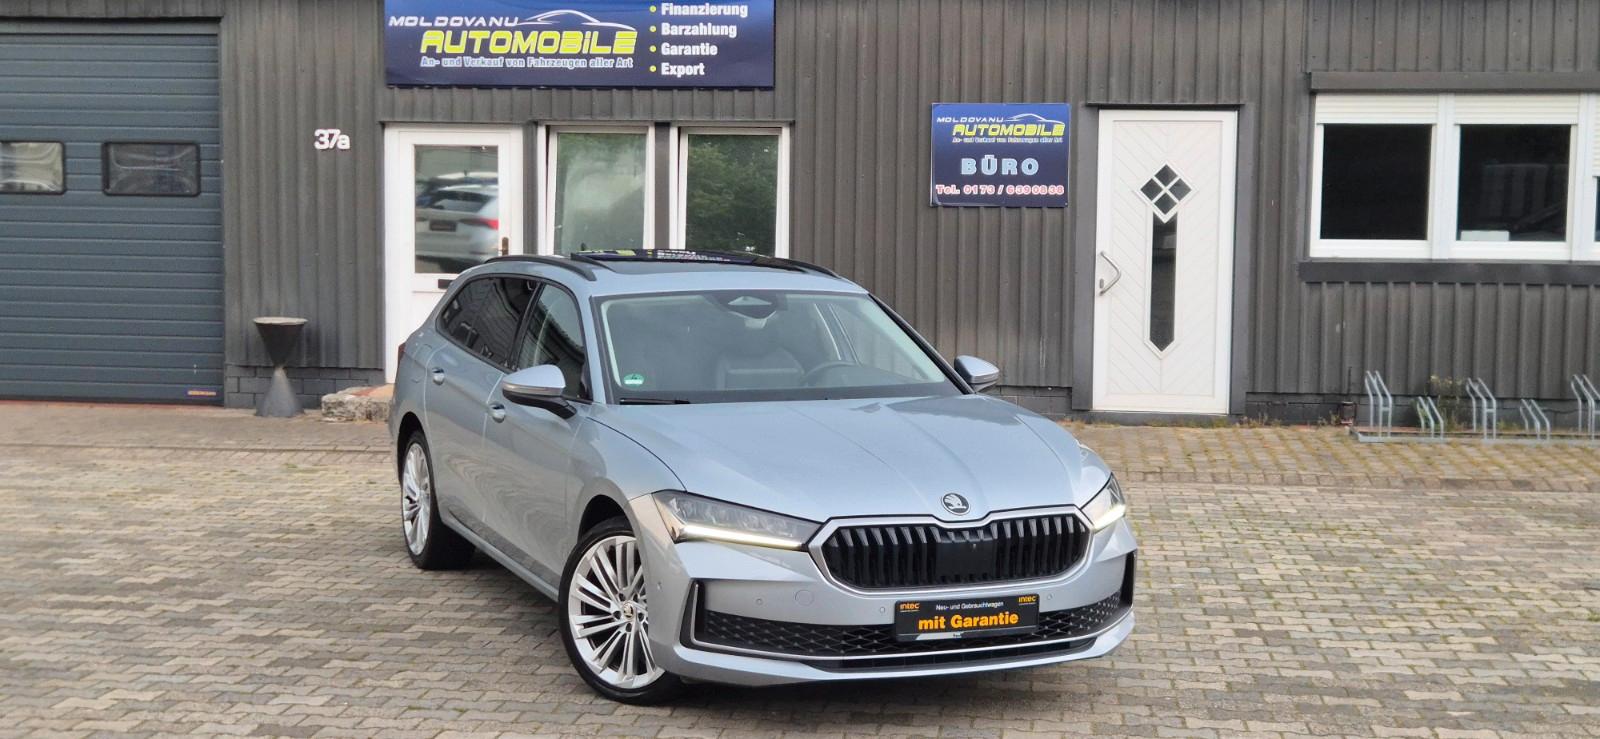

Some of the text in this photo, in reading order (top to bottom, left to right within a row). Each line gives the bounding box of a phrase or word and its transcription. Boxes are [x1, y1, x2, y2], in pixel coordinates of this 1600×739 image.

[661, 2, 748, 18] Finanzierung
[388, 15, 519, 27] MOLDOVANU
[661, 22, 738, 39] Barzahlung
[661, 42, 718, 56] Garantie
[420, 56, 634, 70] An- und Verkauf von Fahrzeugen aller Art
[661, 62, 705, 78] Export
[313, 128, 351, 150] 37a
[960, 154, 1040, 176] BÜRO
[935, 184, 961, 195] Tel.
[963, 184, 996, 195] 0173
[961, 601, 1004, 610] Gebrauchtwagen
[918, 611, 1019, 630] mit Garantie
